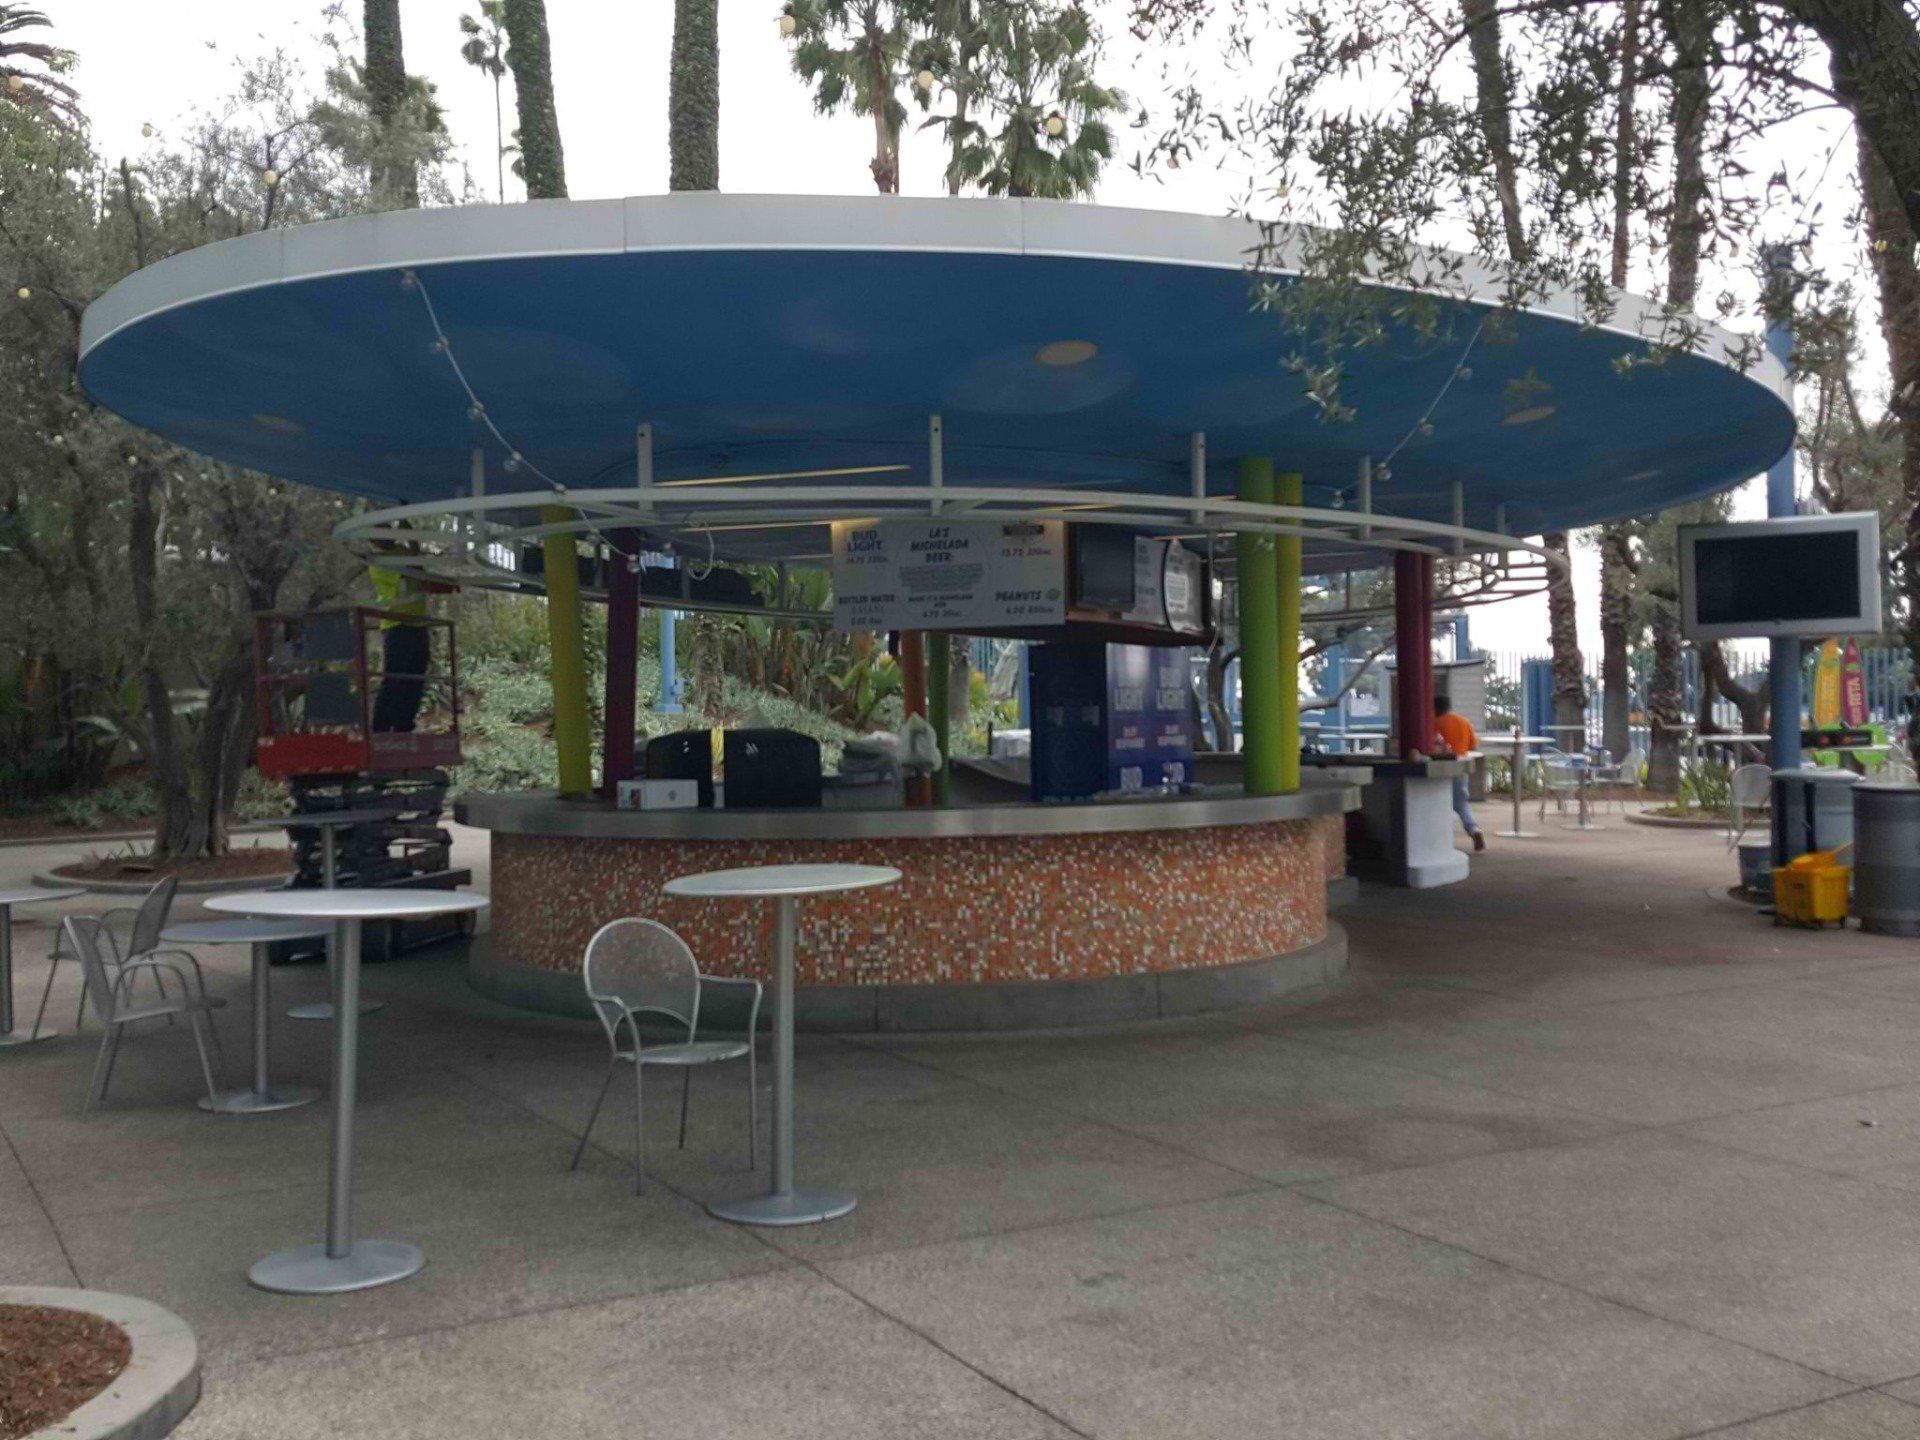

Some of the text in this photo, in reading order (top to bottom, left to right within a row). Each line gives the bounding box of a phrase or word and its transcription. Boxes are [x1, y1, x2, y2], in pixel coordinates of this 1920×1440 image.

[847, 540, 882, 552] LIGHT
[910, 538, 969, 552] MICHELADA
[995, 590, 1042, 601] PEANUTS
